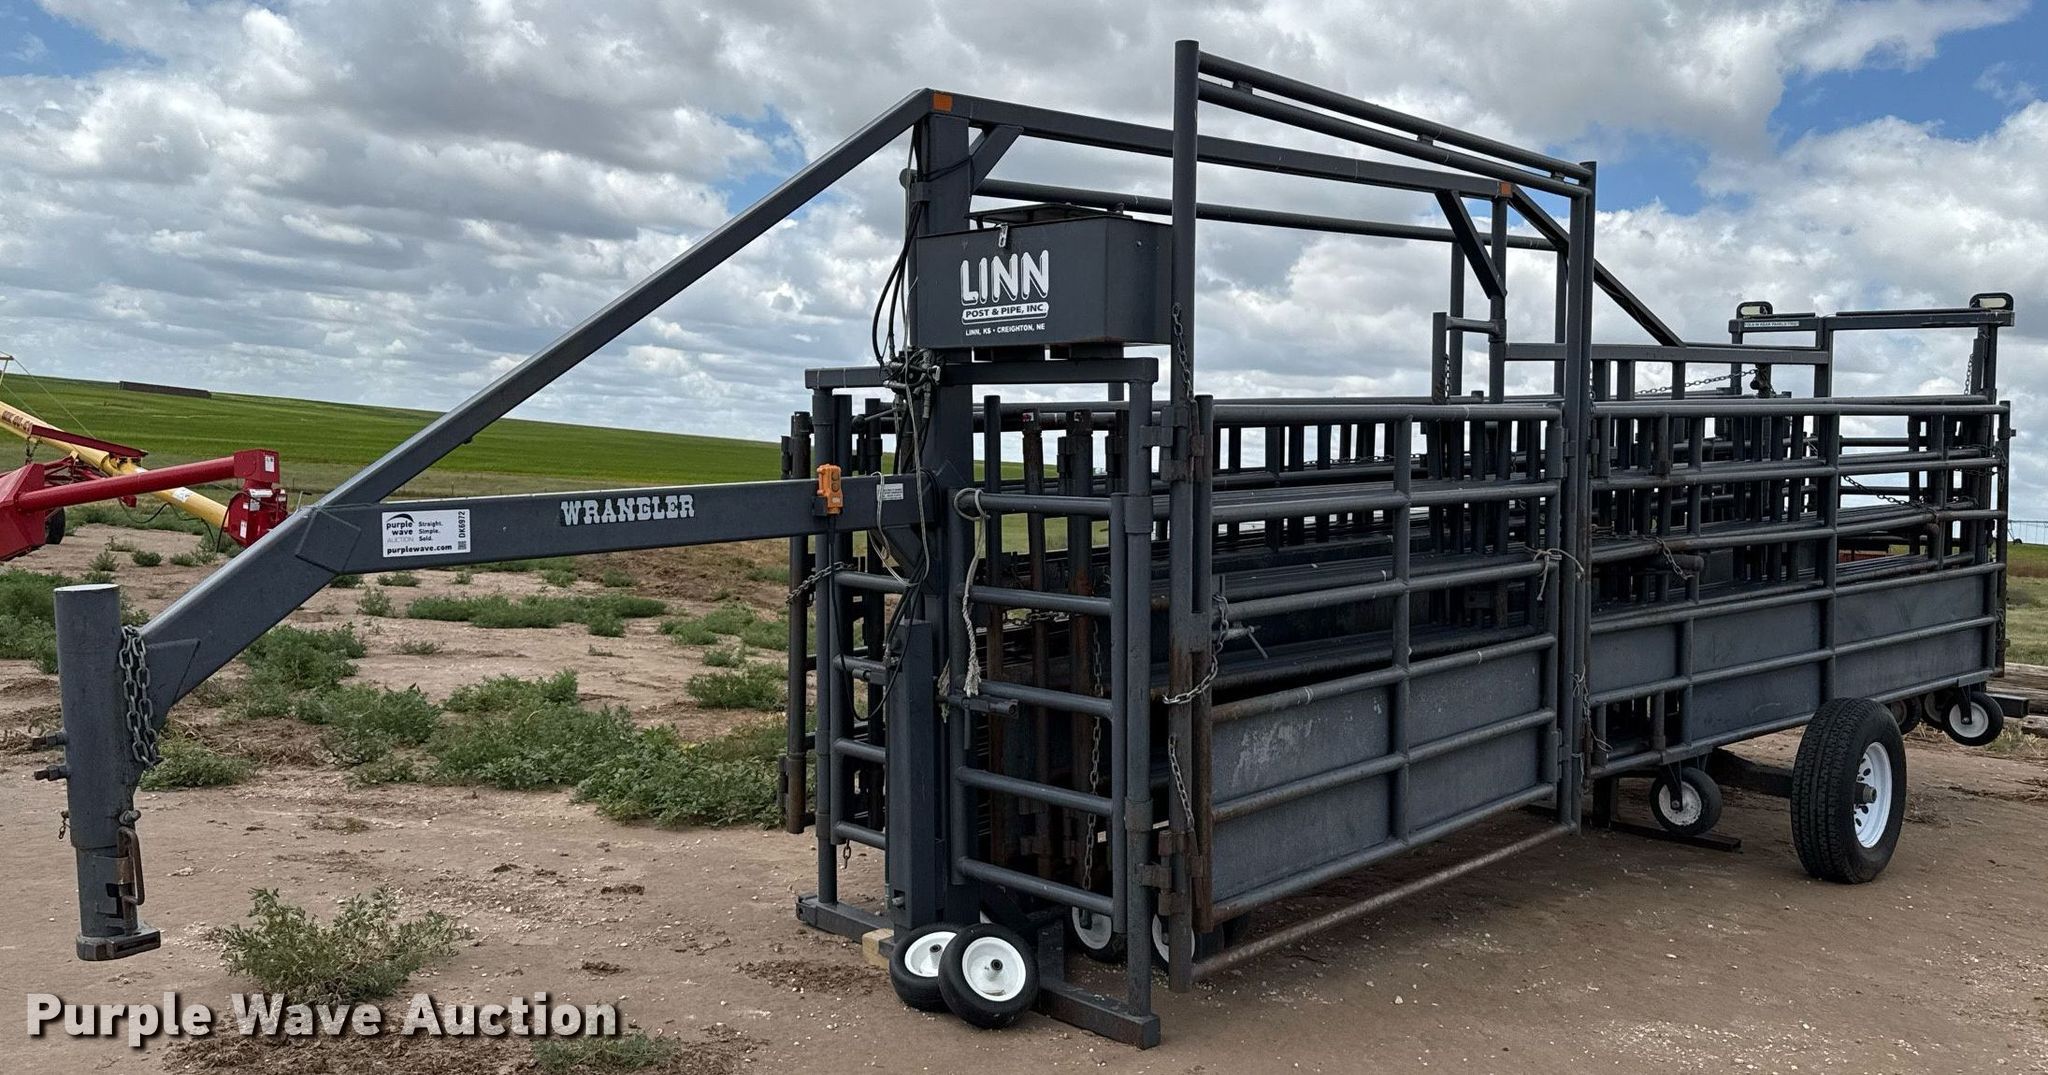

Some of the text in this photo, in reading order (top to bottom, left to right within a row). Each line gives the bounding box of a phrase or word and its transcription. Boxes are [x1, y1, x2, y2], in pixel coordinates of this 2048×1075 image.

[960, 249, 1049, 306] LINN
[965, 309, 989, 318] POST
[991, 308, 999, 316] &
[1001, 305, 1024, 315] PIPE,
[965, 322, 1046, 336] LINN, KS CREIGHTON, NE
[560, 494, 695, 526] WRANGLER
[386, 520, 413, 530] purple
[458, 511, 466, 538] DK6972
[387, 545, 453, 555] purplewave.com
